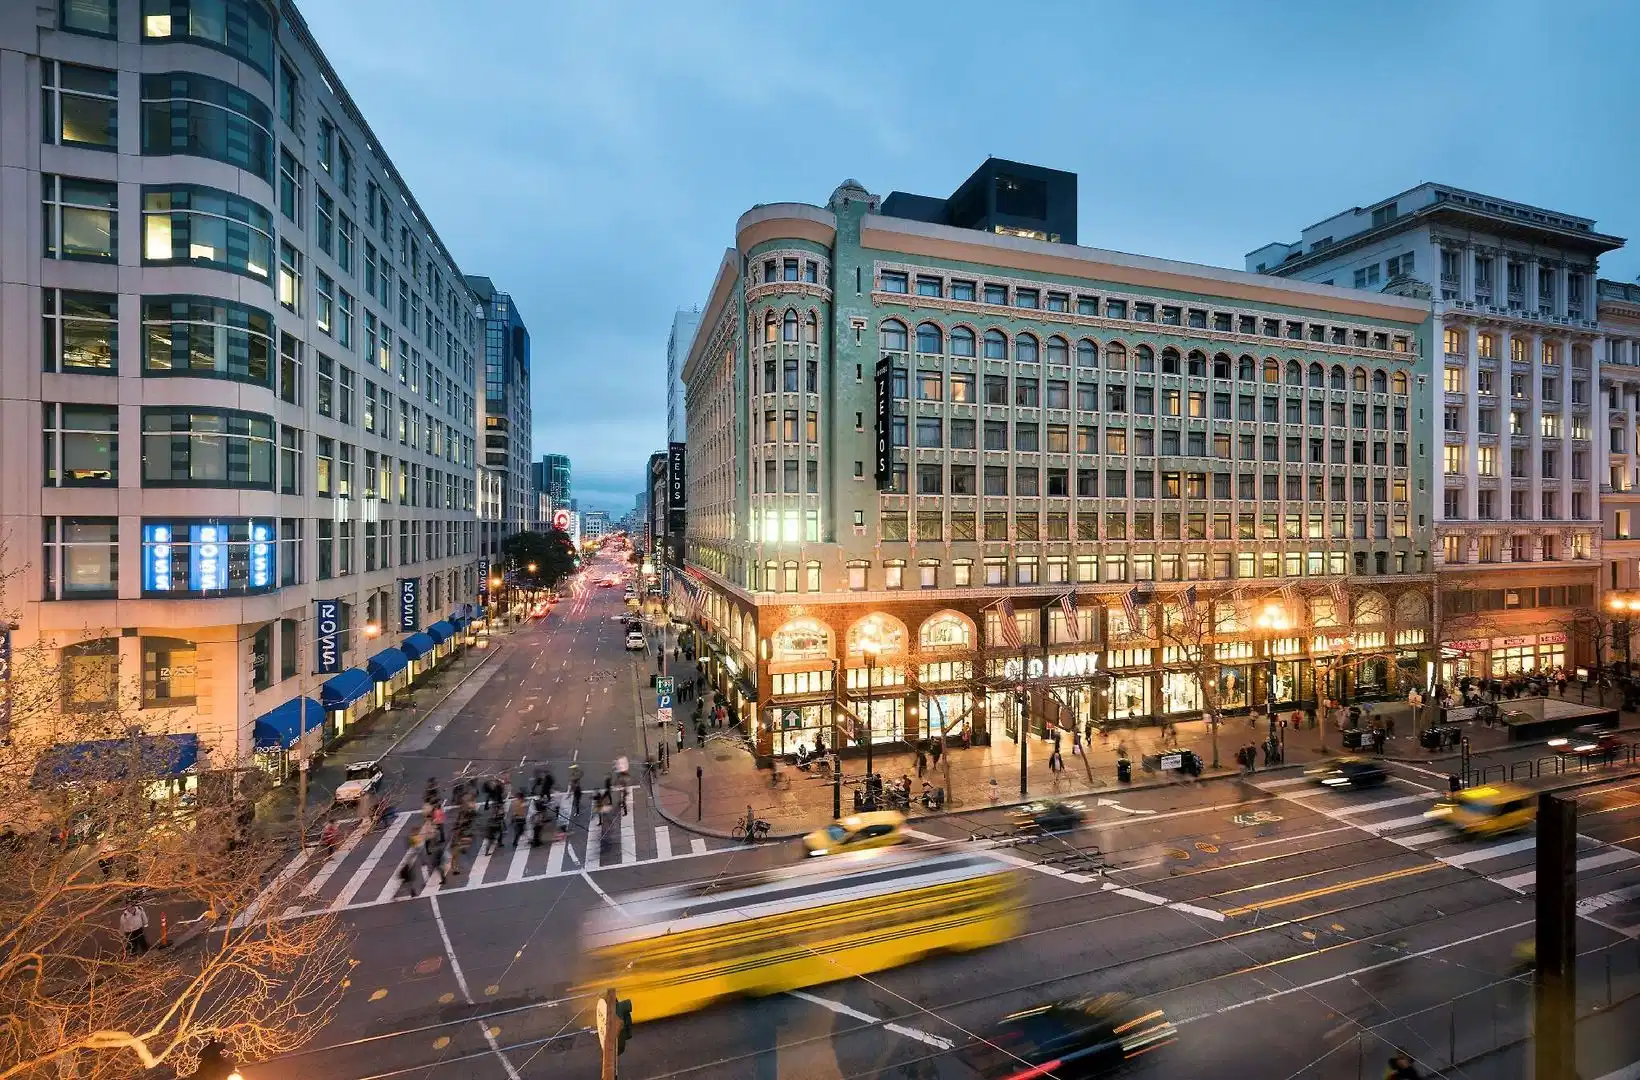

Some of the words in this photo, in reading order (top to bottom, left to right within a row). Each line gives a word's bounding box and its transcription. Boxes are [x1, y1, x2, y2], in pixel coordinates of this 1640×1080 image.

[404, 582, 414, 626] ROSS
[321, 604, 336, 665] ROSS
[1047, 653, 1099, 678] NAVY
[255, 745, 281, 754] ROSS
